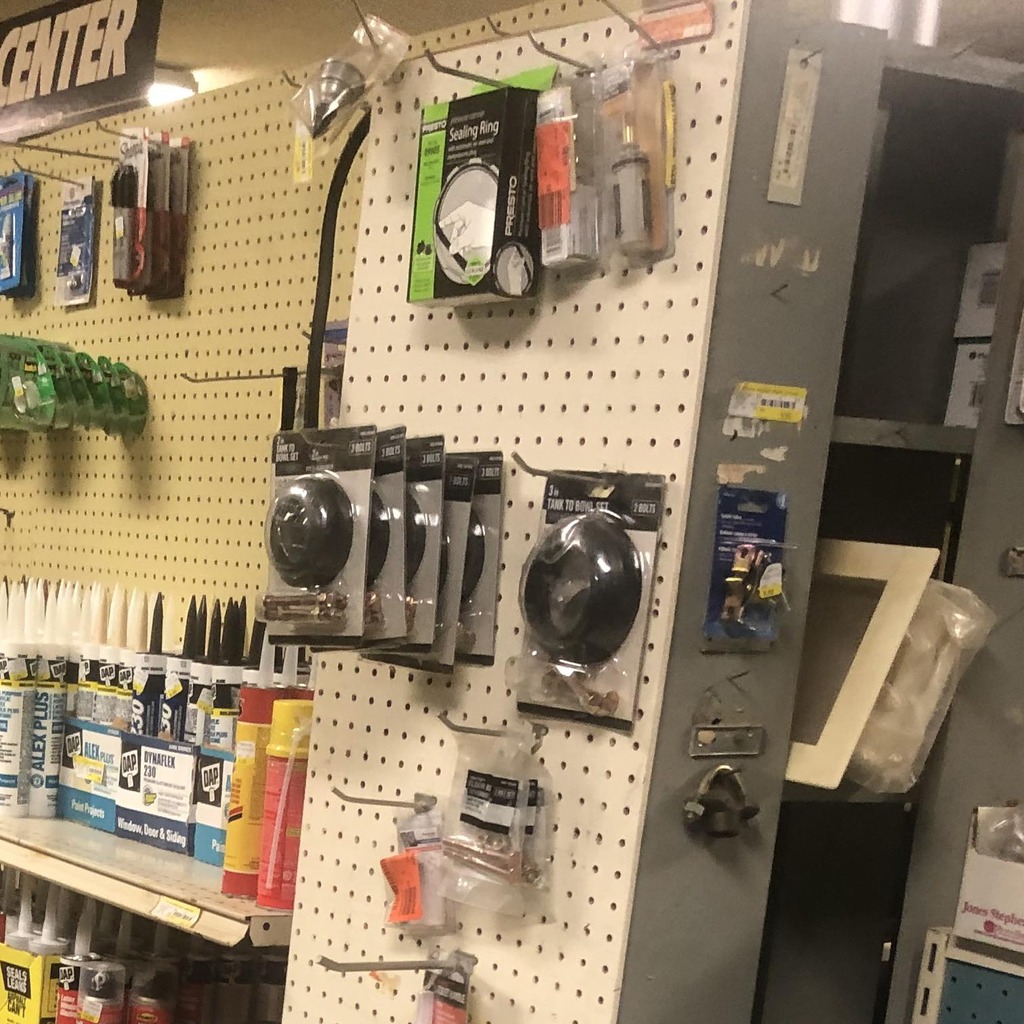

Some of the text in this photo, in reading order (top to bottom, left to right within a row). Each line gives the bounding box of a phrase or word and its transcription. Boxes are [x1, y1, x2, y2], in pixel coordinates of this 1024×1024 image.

[448, 120, 500, 142] Sealing Ring
[504, 175, 518, 237] PRESTO
[356, 441, 371, 453] BOLTS
[381, 445, 401, 457] 3 BOLTS
[291, 451, 300, 461] SET
[422, 453, 441, 464] 3 BOLTS
[481, 466, 500, 477] 3 BOLTS
[453, 476, 469, 486] BOLTS
[548, 484, 554, 496] 3
[547, 498, 610, 512] TANK TO BOWL SET
[637, 501, 656, 514] BOLTS
[101, 666, 114, 678] DAP
[119, 670, 131, 681] DAP
[32, 691, 49, 771] ALEX PLUS
[84, 741, 115, 765] ALEX PLUS
[143, 750, 176, 770] DYNAFLEX
[122, 753, 137, 774] DAP
[143, 764, 157, 779] 230
[203, 767, 219, 788] DAP
[71, 798, 105, 820] Paint Projects
[117, 816, 187, 848] Window, Door & Siding
[961, 901, 988, 917] Jones
[6, 965, 27, 982] SEALS
[6, 976, 27, 994] LEAKS
